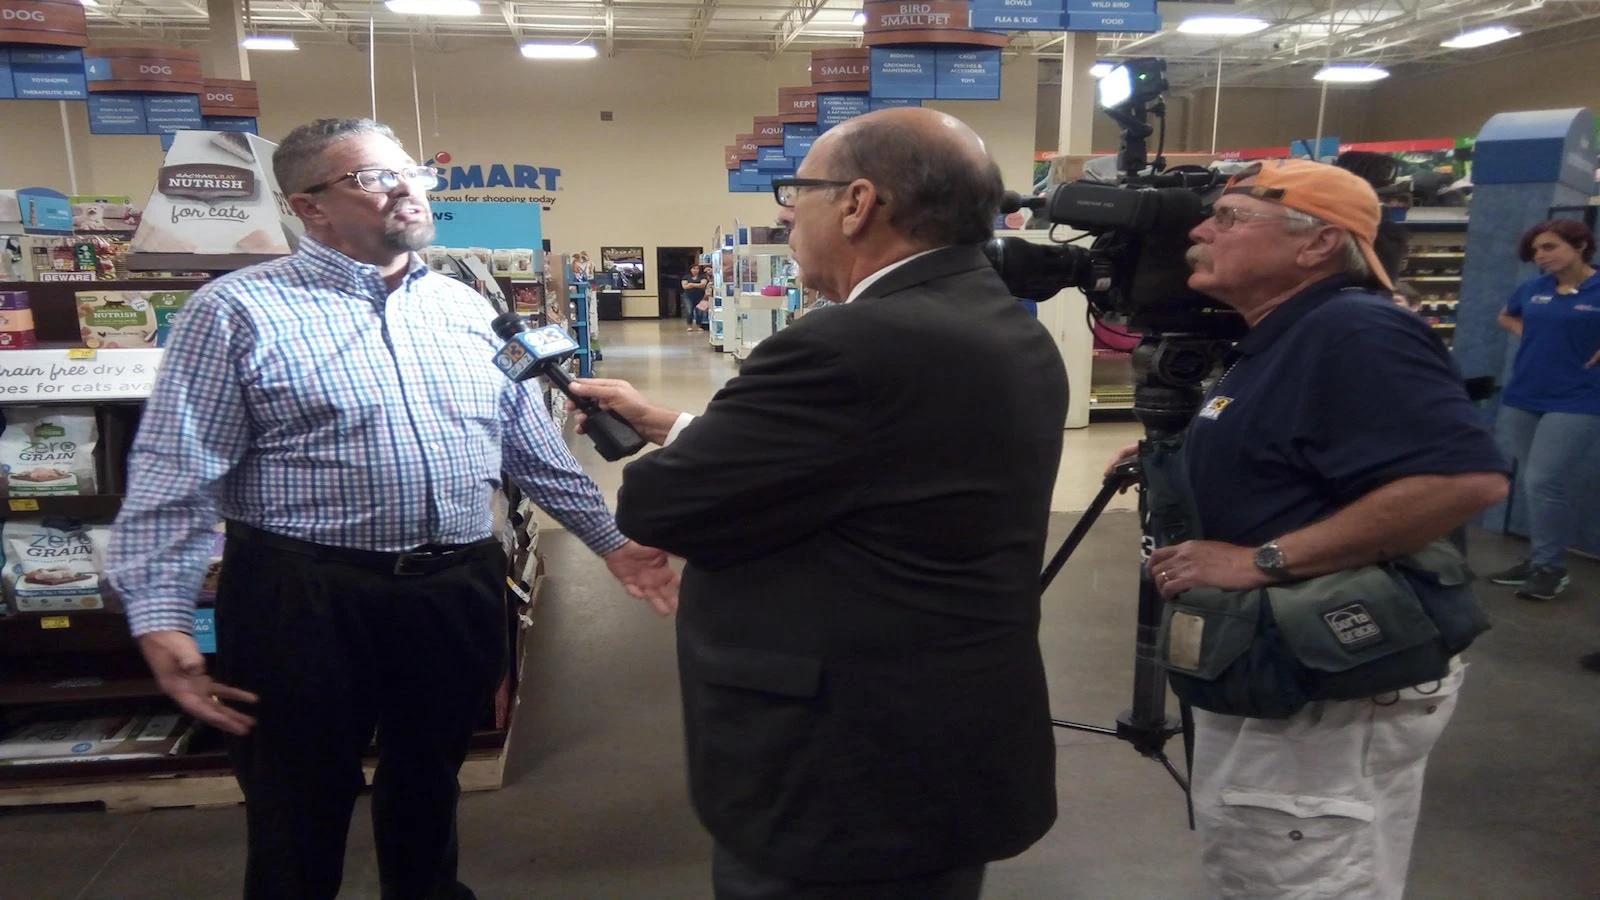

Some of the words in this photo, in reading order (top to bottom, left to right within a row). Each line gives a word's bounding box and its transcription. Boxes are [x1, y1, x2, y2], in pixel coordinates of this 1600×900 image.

[899, 4, 931, 14] BIRD
[3, 9, 45, 22] DOG
[880, 16, 925, 26] SMALL
[927, 15, 950, 25] PET
[89, 65, 96, 74] 4
[139, 64, 172, 76] DOG
[820, 66, 859, 75] SMALL
[206, 93, 234, 102] DOG
[168, 178, 244, 189] NUTRISH
[465, 194, 479, 202] for
[482, 195, 526, 203] shopping
[529, 195, 556, 204] today
[171, 205, 205, 223] for
[209, 205, 249, 219] cats
[0, 366, 44, 377] rain
[50, 364, 88, 381] free
[93, 364, 126, 378] dry
[132, 364, 145, 374] &
[36, 383, 64, 393] for
[71, 382, 111, 392] cats
[19, 452, 76, 461] GRAIN
[26, 545, 93, 557] GRAIN
